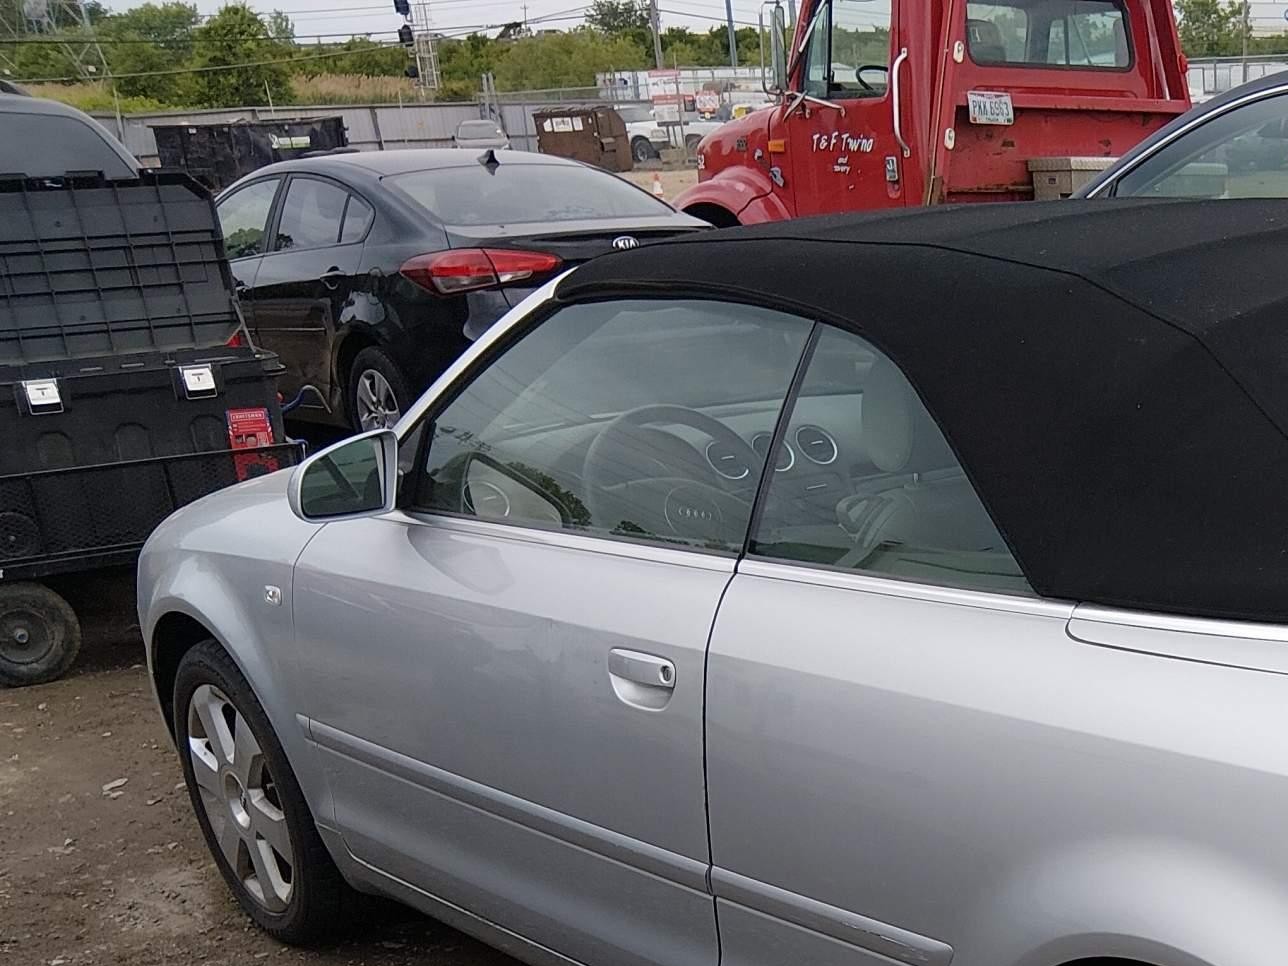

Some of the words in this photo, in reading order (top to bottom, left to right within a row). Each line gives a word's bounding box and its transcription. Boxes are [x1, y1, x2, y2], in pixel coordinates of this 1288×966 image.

[812, 133, 820, 153] T
[819, 135, 828, 150] &
[829, 131, 839, 152] F
[616, 239, 636, 249] KIA
